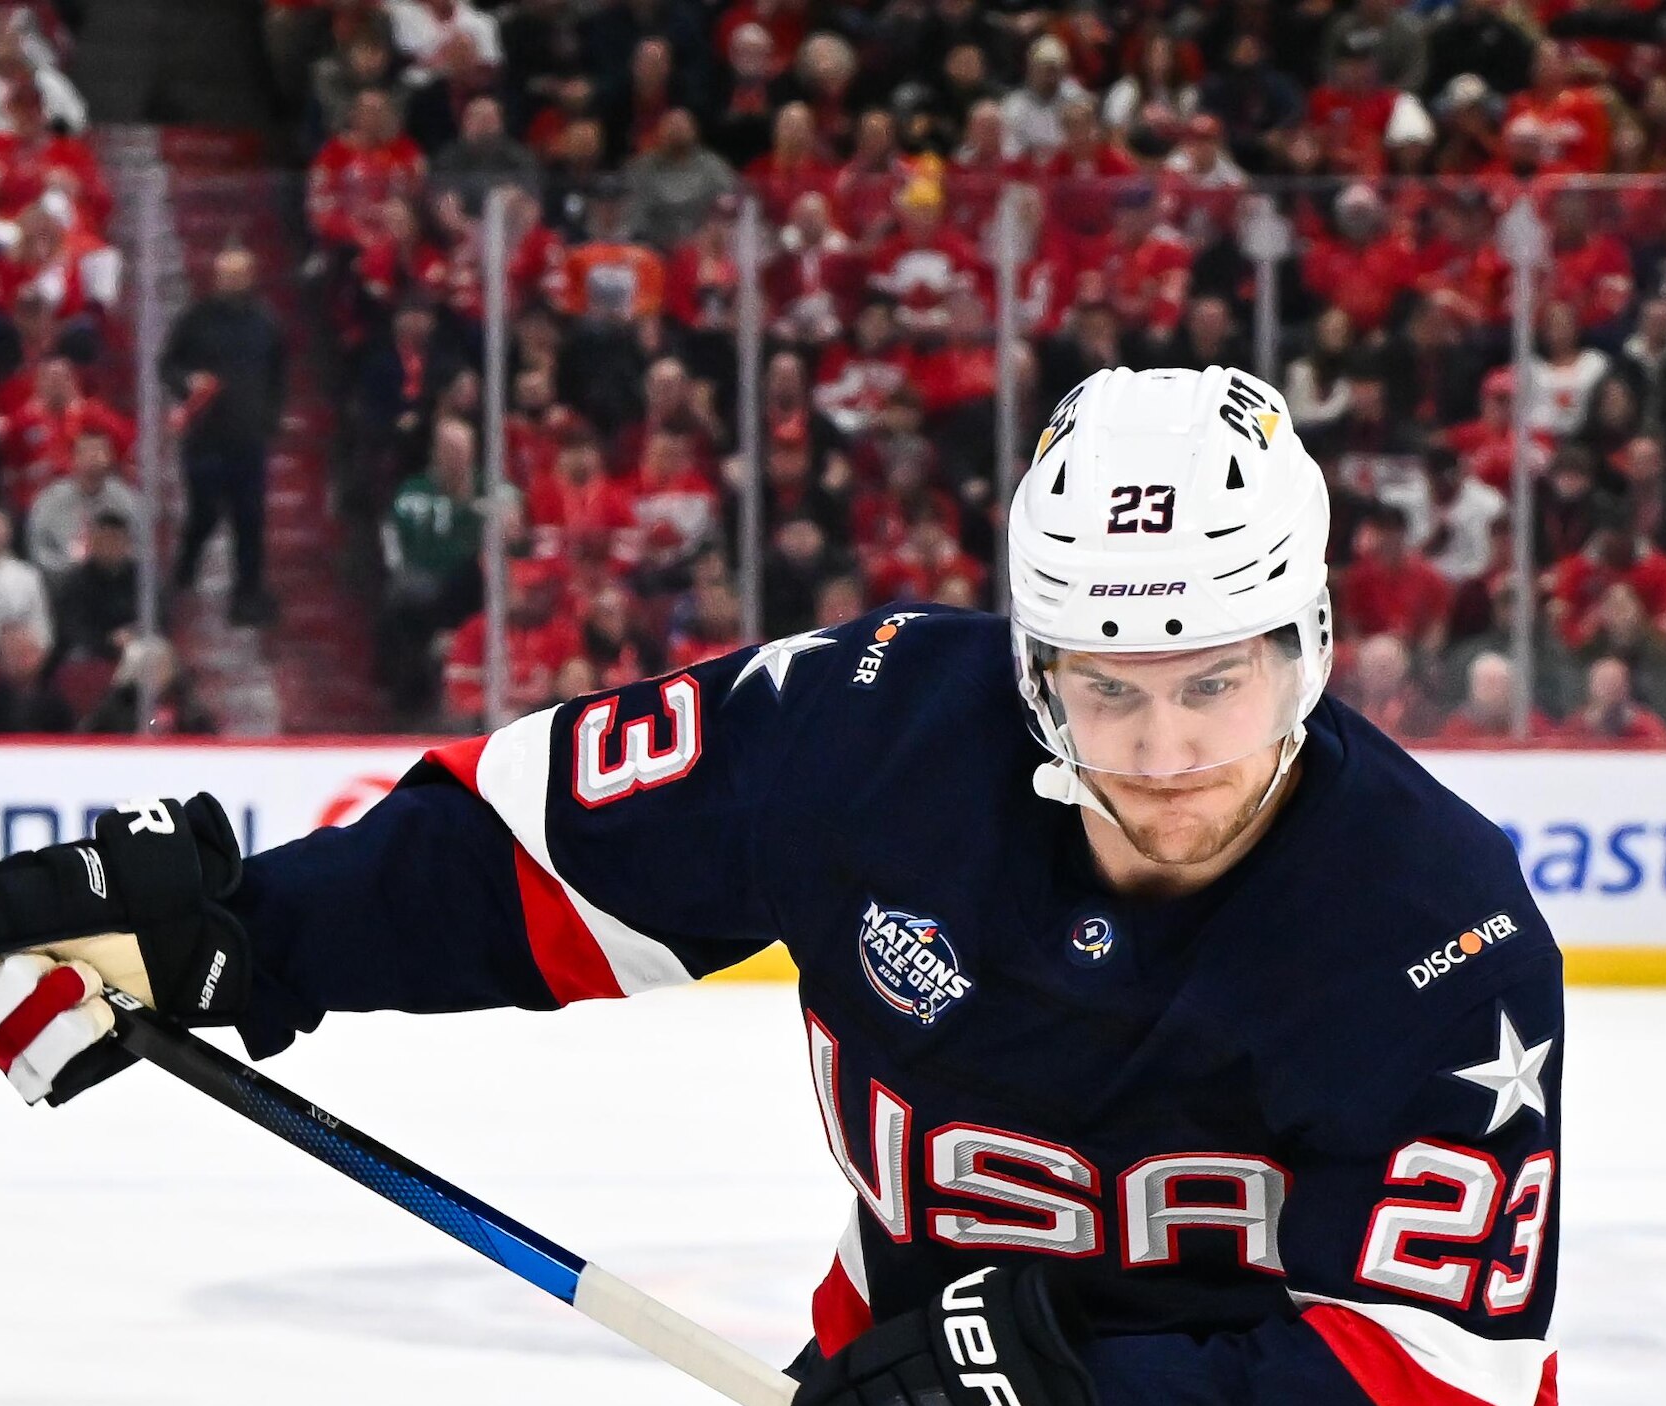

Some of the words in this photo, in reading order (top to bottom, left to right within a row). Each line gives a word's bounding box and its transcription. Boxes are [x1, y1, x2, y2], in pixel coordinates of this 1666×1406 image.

[1107, 484, 1176, 534] 23
[1088, 581, 1187, 597] BAUER
[862, 900, 973, 999] NATIONS
[877, 963, 903, 989] 2025
[1406, 914, 1518, 990] DISCOVER
[806, 1007, 1294, 1278] USA
[1353, 1136, 1556, 1317] 23
